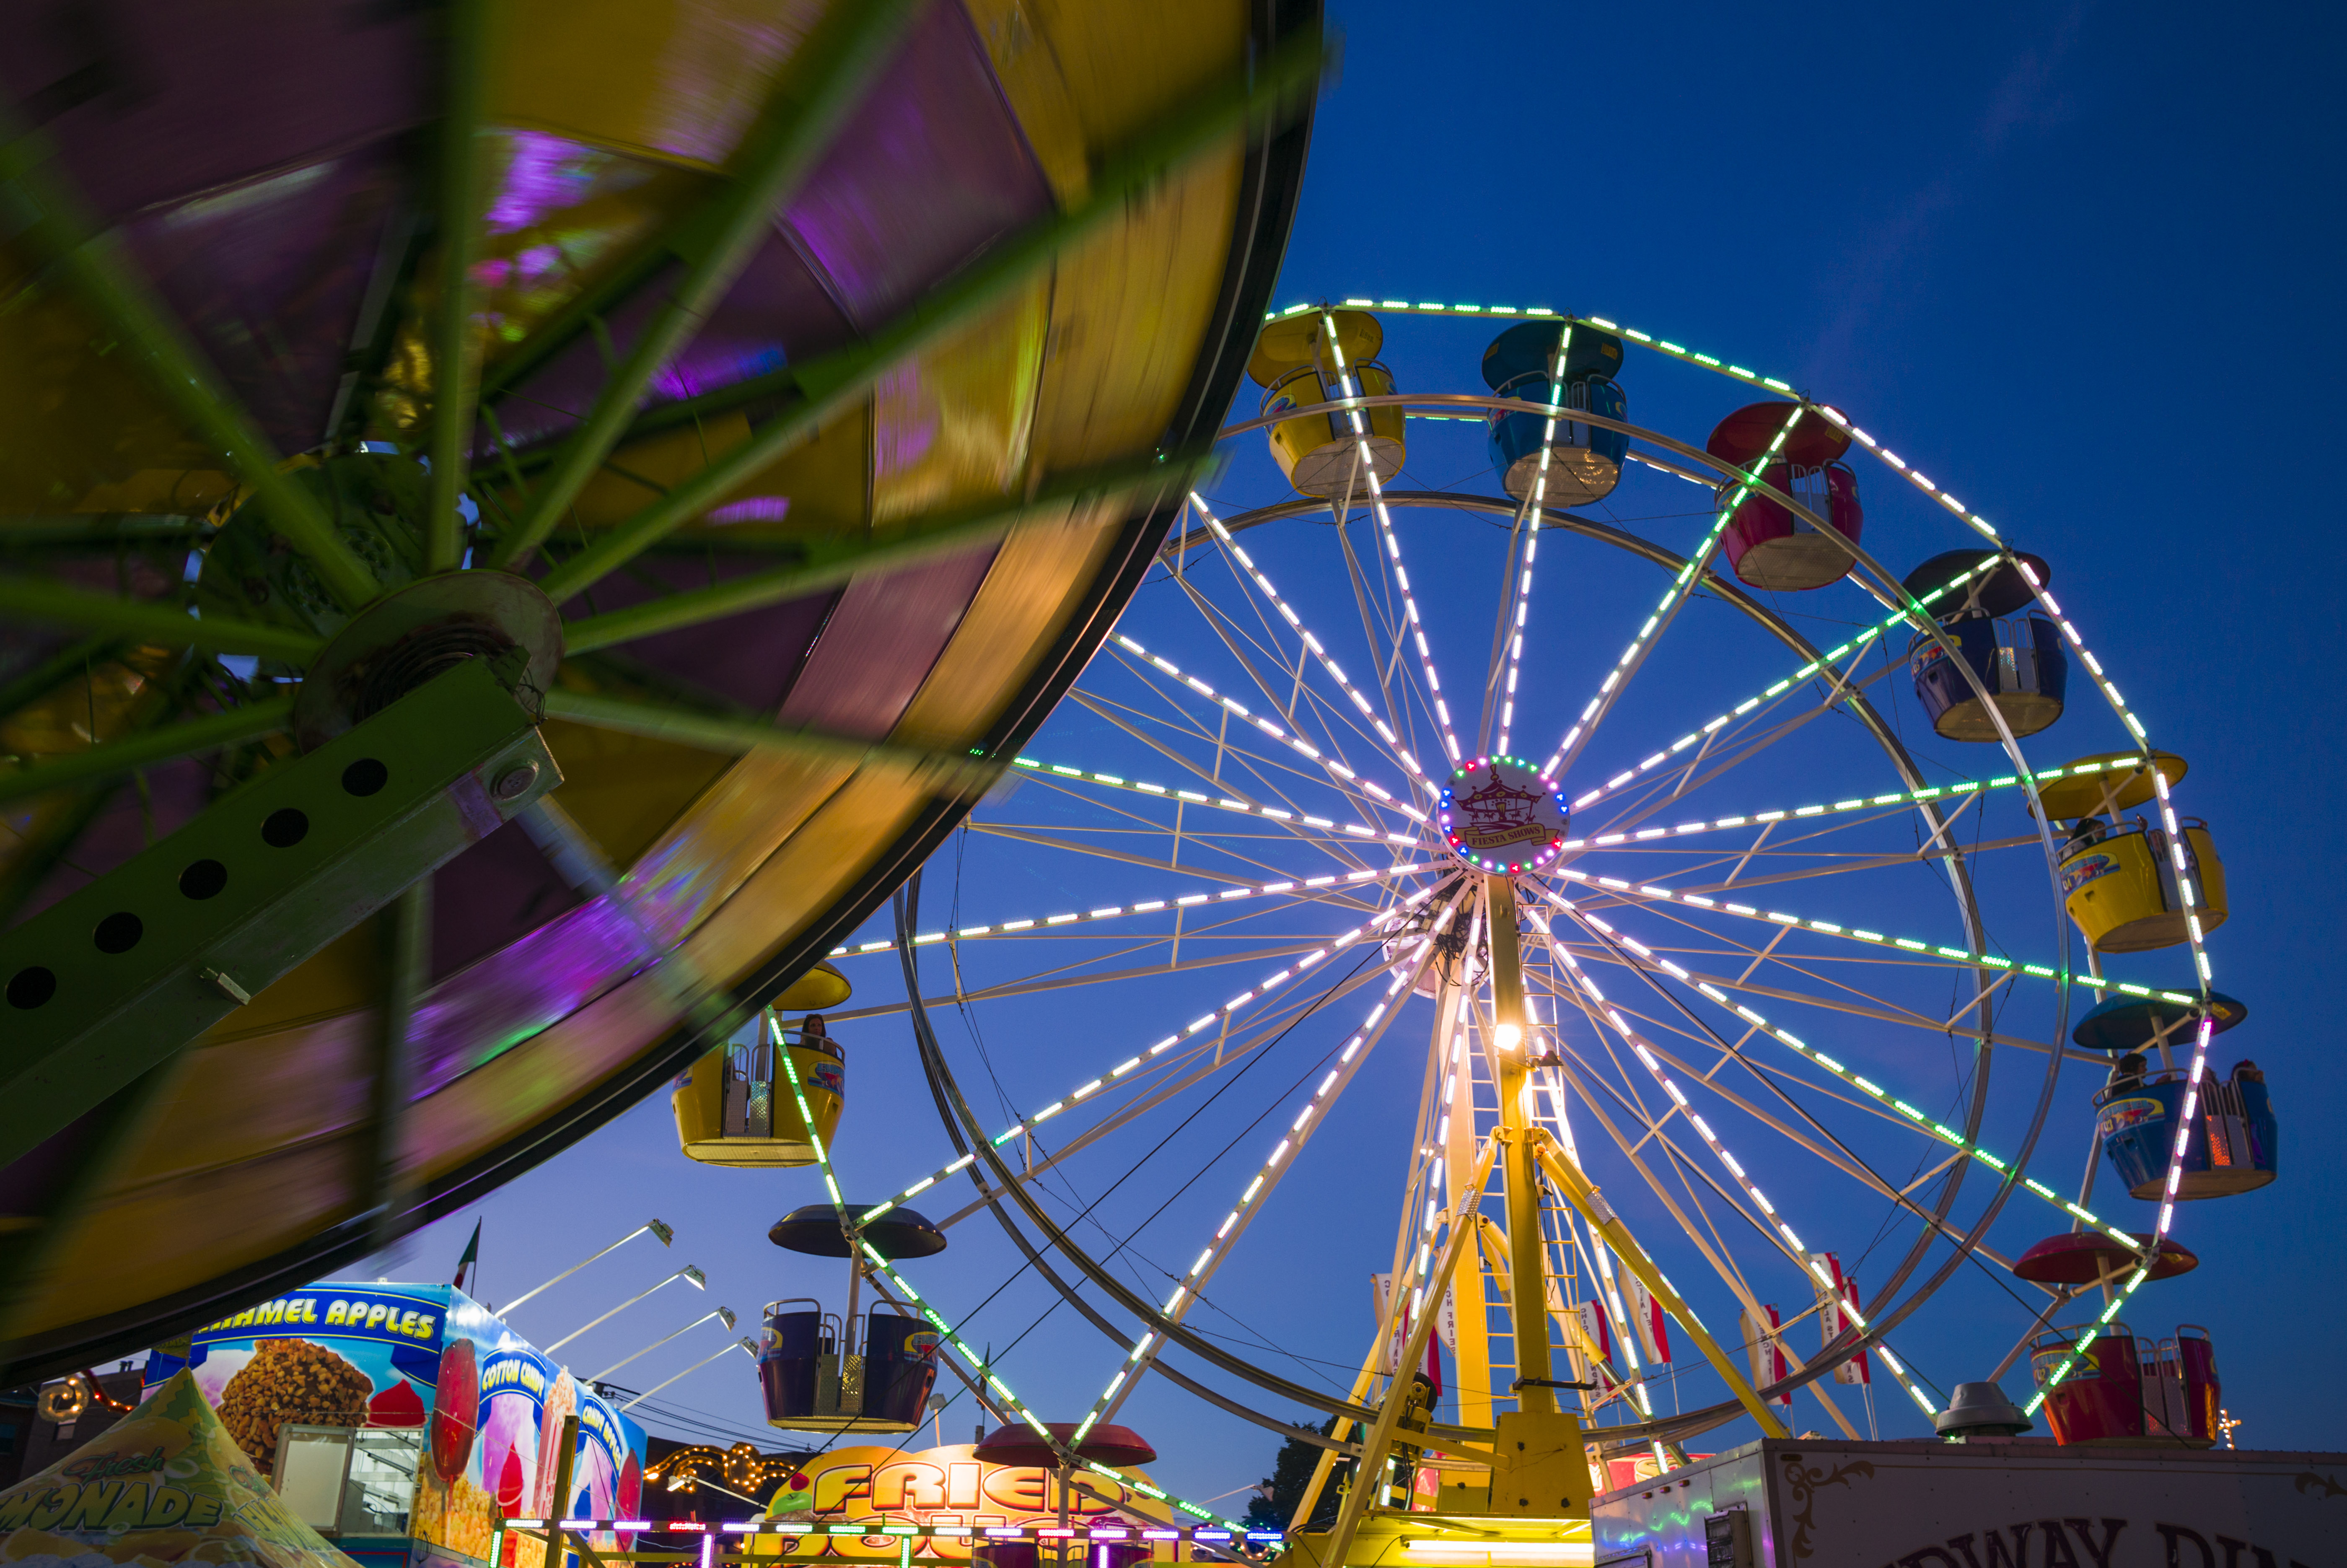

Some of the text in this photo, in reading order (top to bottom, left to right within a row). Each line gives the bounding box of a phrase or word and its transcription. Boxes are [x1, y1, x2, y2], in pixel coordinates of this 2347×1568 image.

[1472, 826, 1541, 845] FIESTA SHOWS
[198, 1298, 436, 1340] AMEL APPLES
[482, 1359, 545, 1399] COTTON CANDY
[582, 1405, 621, 1471] CANDY APPLES
[62, 1446, 166, 1485] Fresh
[0, 1480, 224, 1533] MONADE
[812, 1461, 1127, 1516] FRIED
